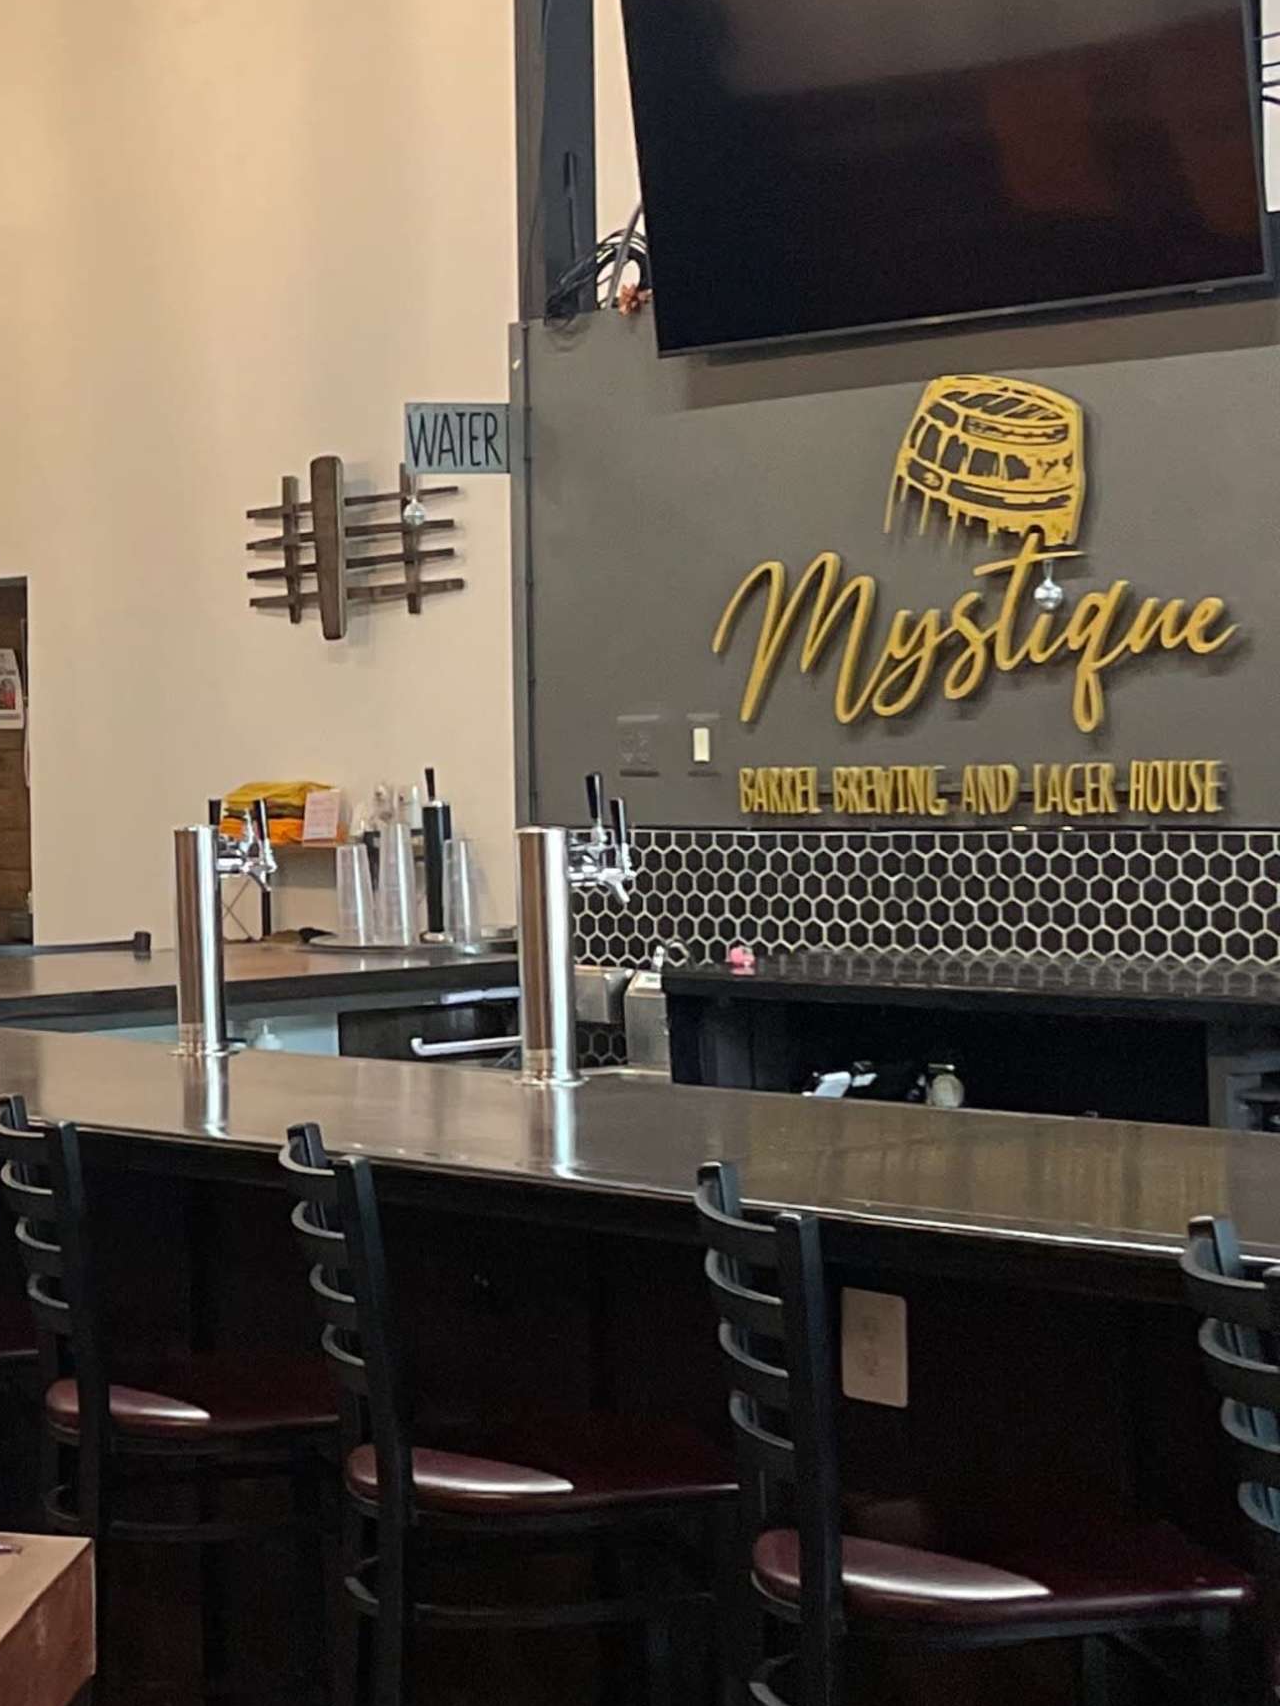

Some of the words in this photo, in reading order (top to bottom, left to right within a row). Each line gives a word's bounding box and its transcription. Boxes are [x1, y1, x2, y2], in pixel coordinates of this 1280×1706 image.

[406, 411, 502, 468] WATER
[711, 531, 1240, 733] Mystique
[739, 766, 822, 814] BARREL
[832, 764, 947, 816] BREWING
[961, 764, 1020, 815] AND
[1032, 761, 1118, 816] LAGER
[1128, 759, 1225, 814] HOUSE
